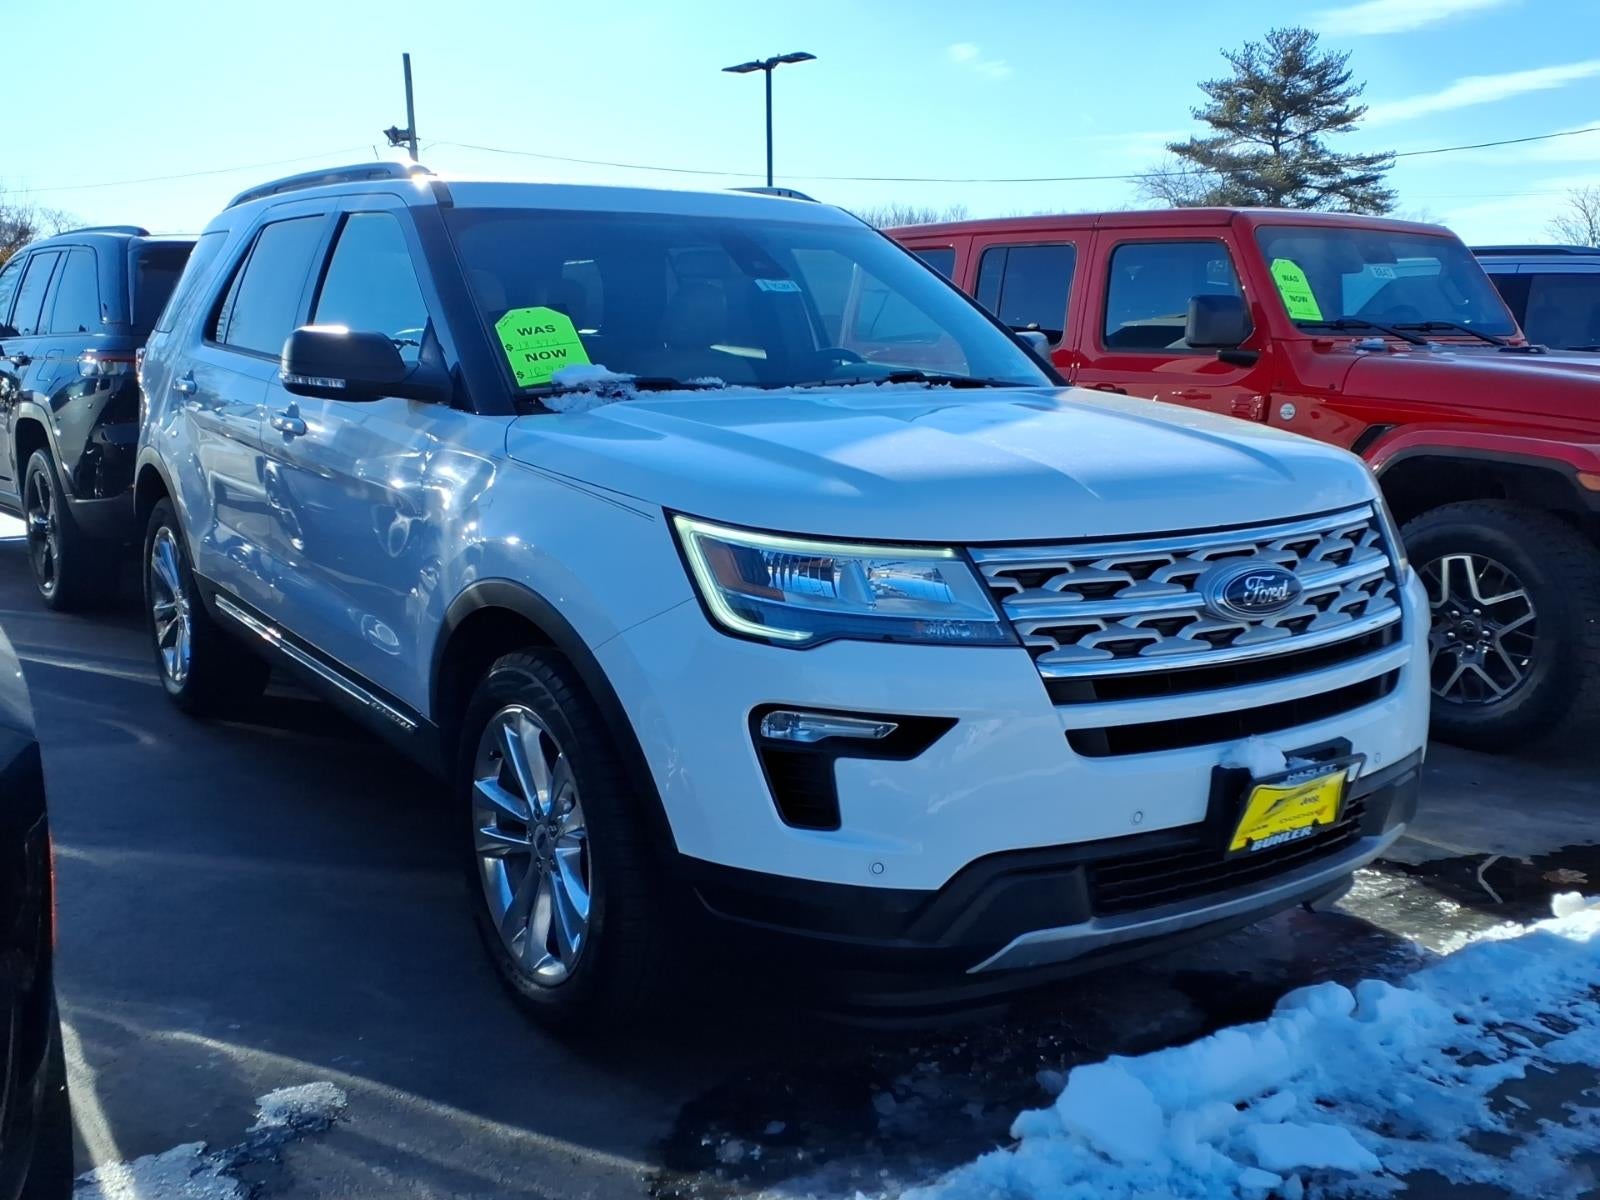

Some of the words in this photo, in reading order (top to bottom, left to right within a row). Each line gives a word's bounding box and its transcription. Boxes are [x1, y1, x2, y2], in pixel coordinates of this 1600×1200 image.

[517, 324, 556, 336] WAS
[525, 349, 567, 362] NOW
[1243, 575, 1289, 605] Ford
